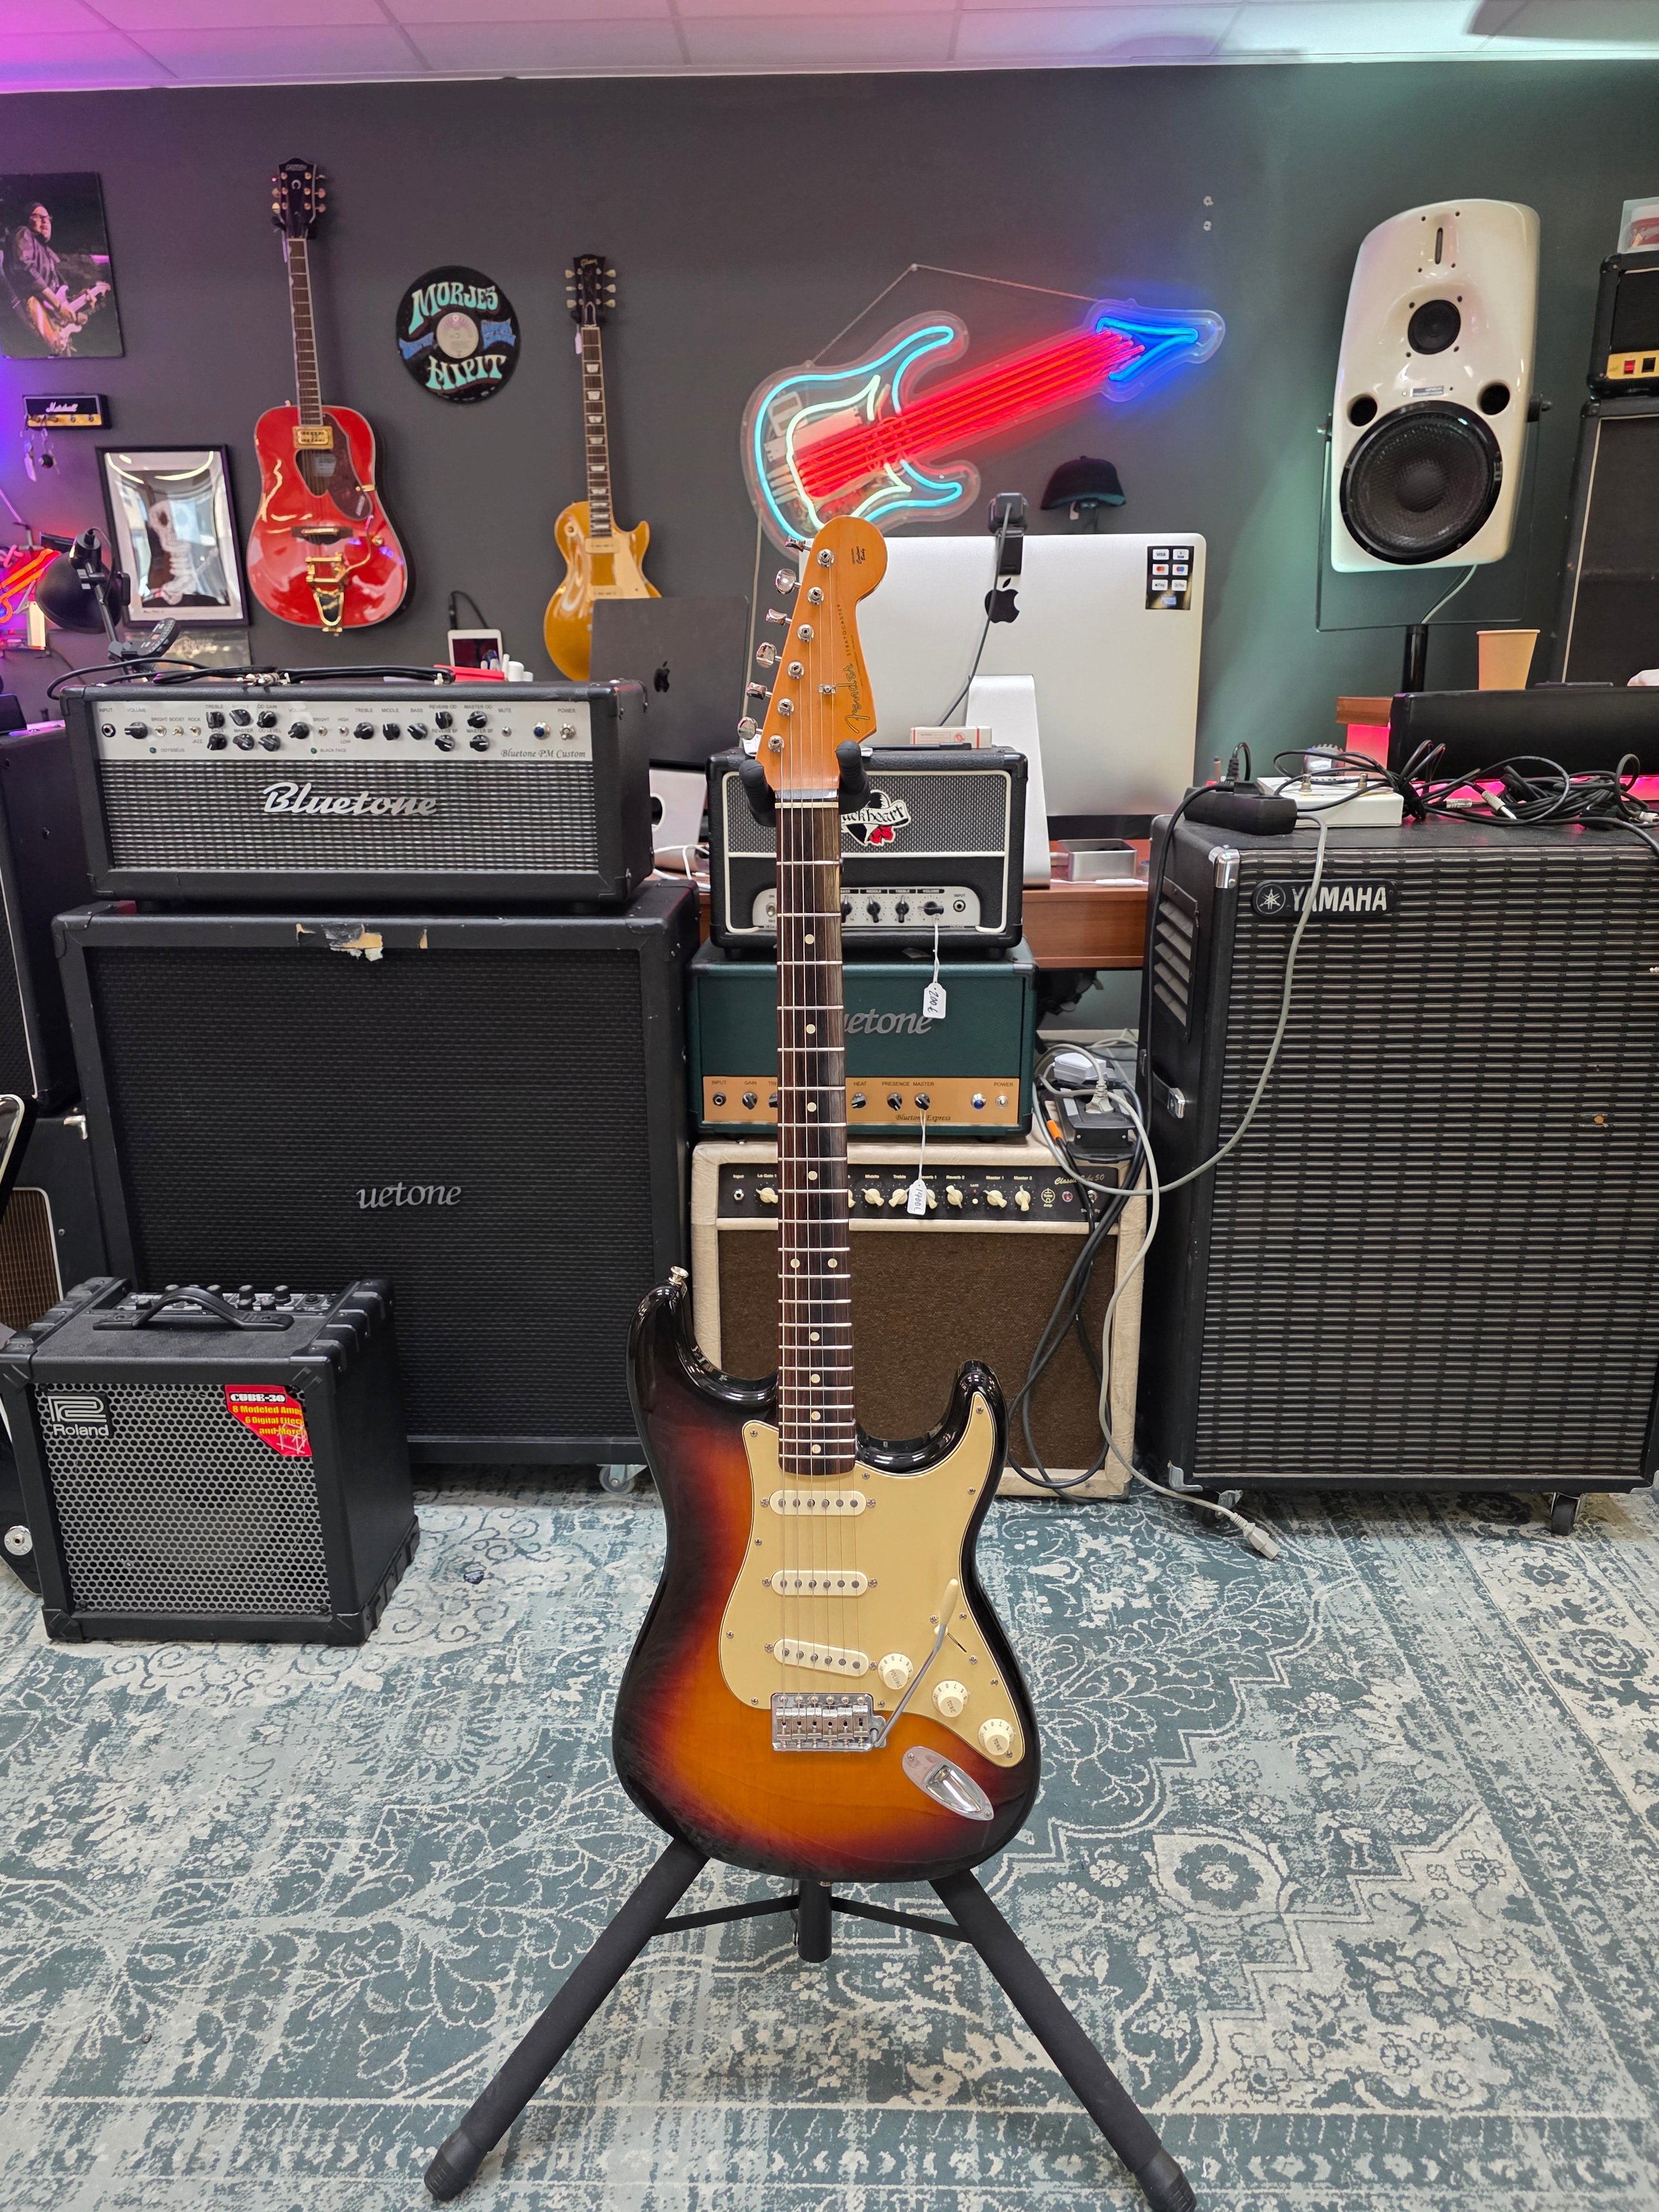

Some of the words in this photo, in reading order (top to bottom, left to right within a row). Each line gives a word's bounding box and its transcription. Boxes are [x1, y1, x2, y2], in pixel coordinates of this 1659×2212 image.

[837, 604, 851, 656] STRATOCASTER
[837, 664, 870, 733] Fender
[500, 749, 536, 758] Bluetone
[556, 749, 586, 758] Custom
[263, 782, 437, 815] Bluetone
[1291, 886, 1387, 912] YAMAHA
[356, 1182, 462, 1209] uetone
[230, 1394, 285, 1402] CUBE-30
[240, 1405, 279, 1413] Modeled
[252, 1416, 279, 1425] Digital
[53, 1423, 109, 1436] Roland
[890, 1669, 902, 1688] VOLUME
[946, 1700, 956, 1713] TONE
[993, 1738, 1003, 1751] TONE
